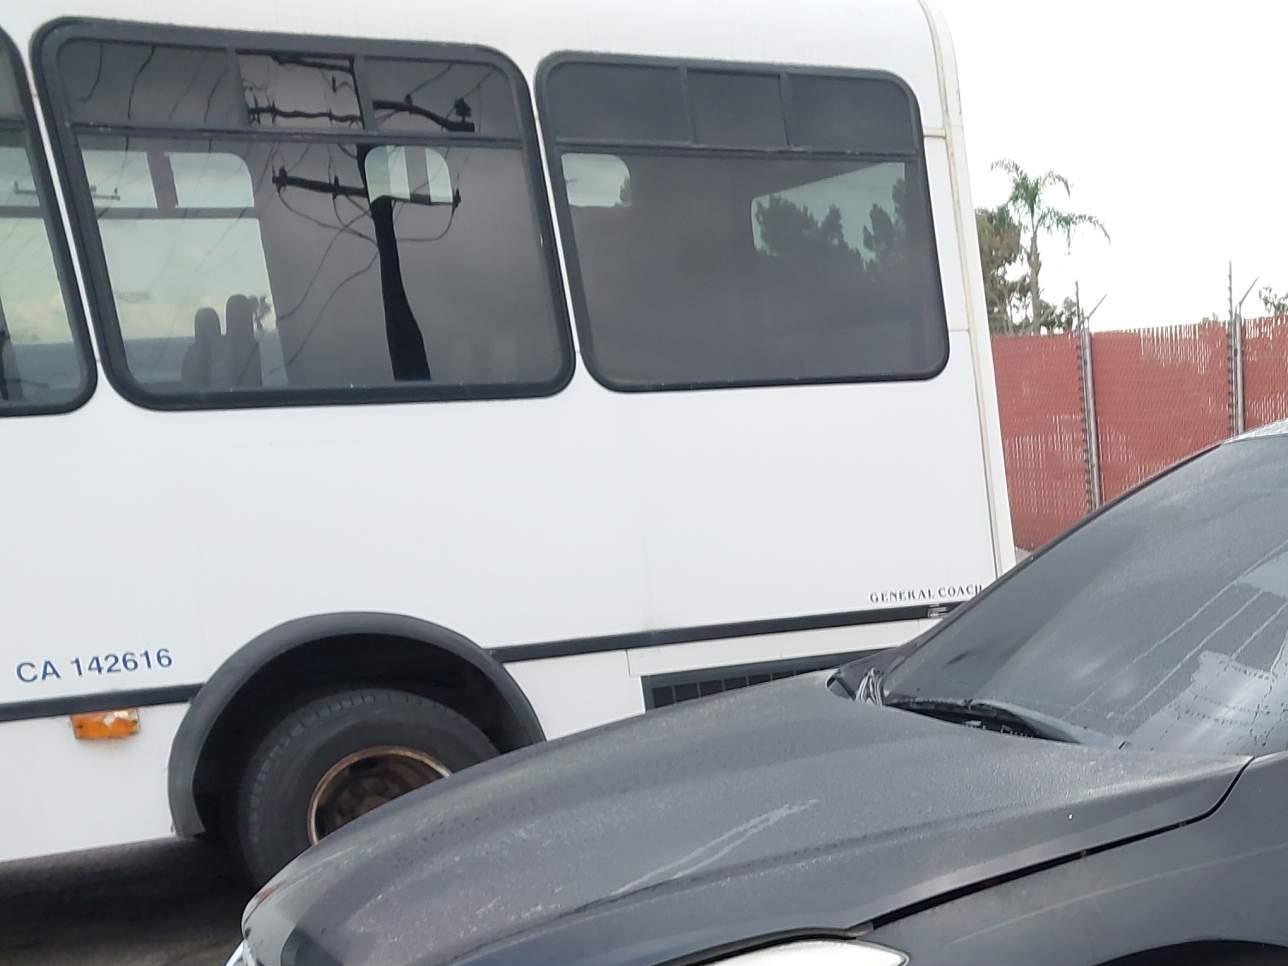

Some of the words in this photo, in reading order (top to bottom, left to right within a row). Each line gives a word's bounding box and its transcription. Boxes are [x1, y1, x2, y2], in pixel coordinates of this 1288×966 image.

[869, 588, 935, 602] GENERAL
[938, 584, 982, 597] COACH
[16, 659, 61, 683] CA
[70, 648, 172, 676] 142616
